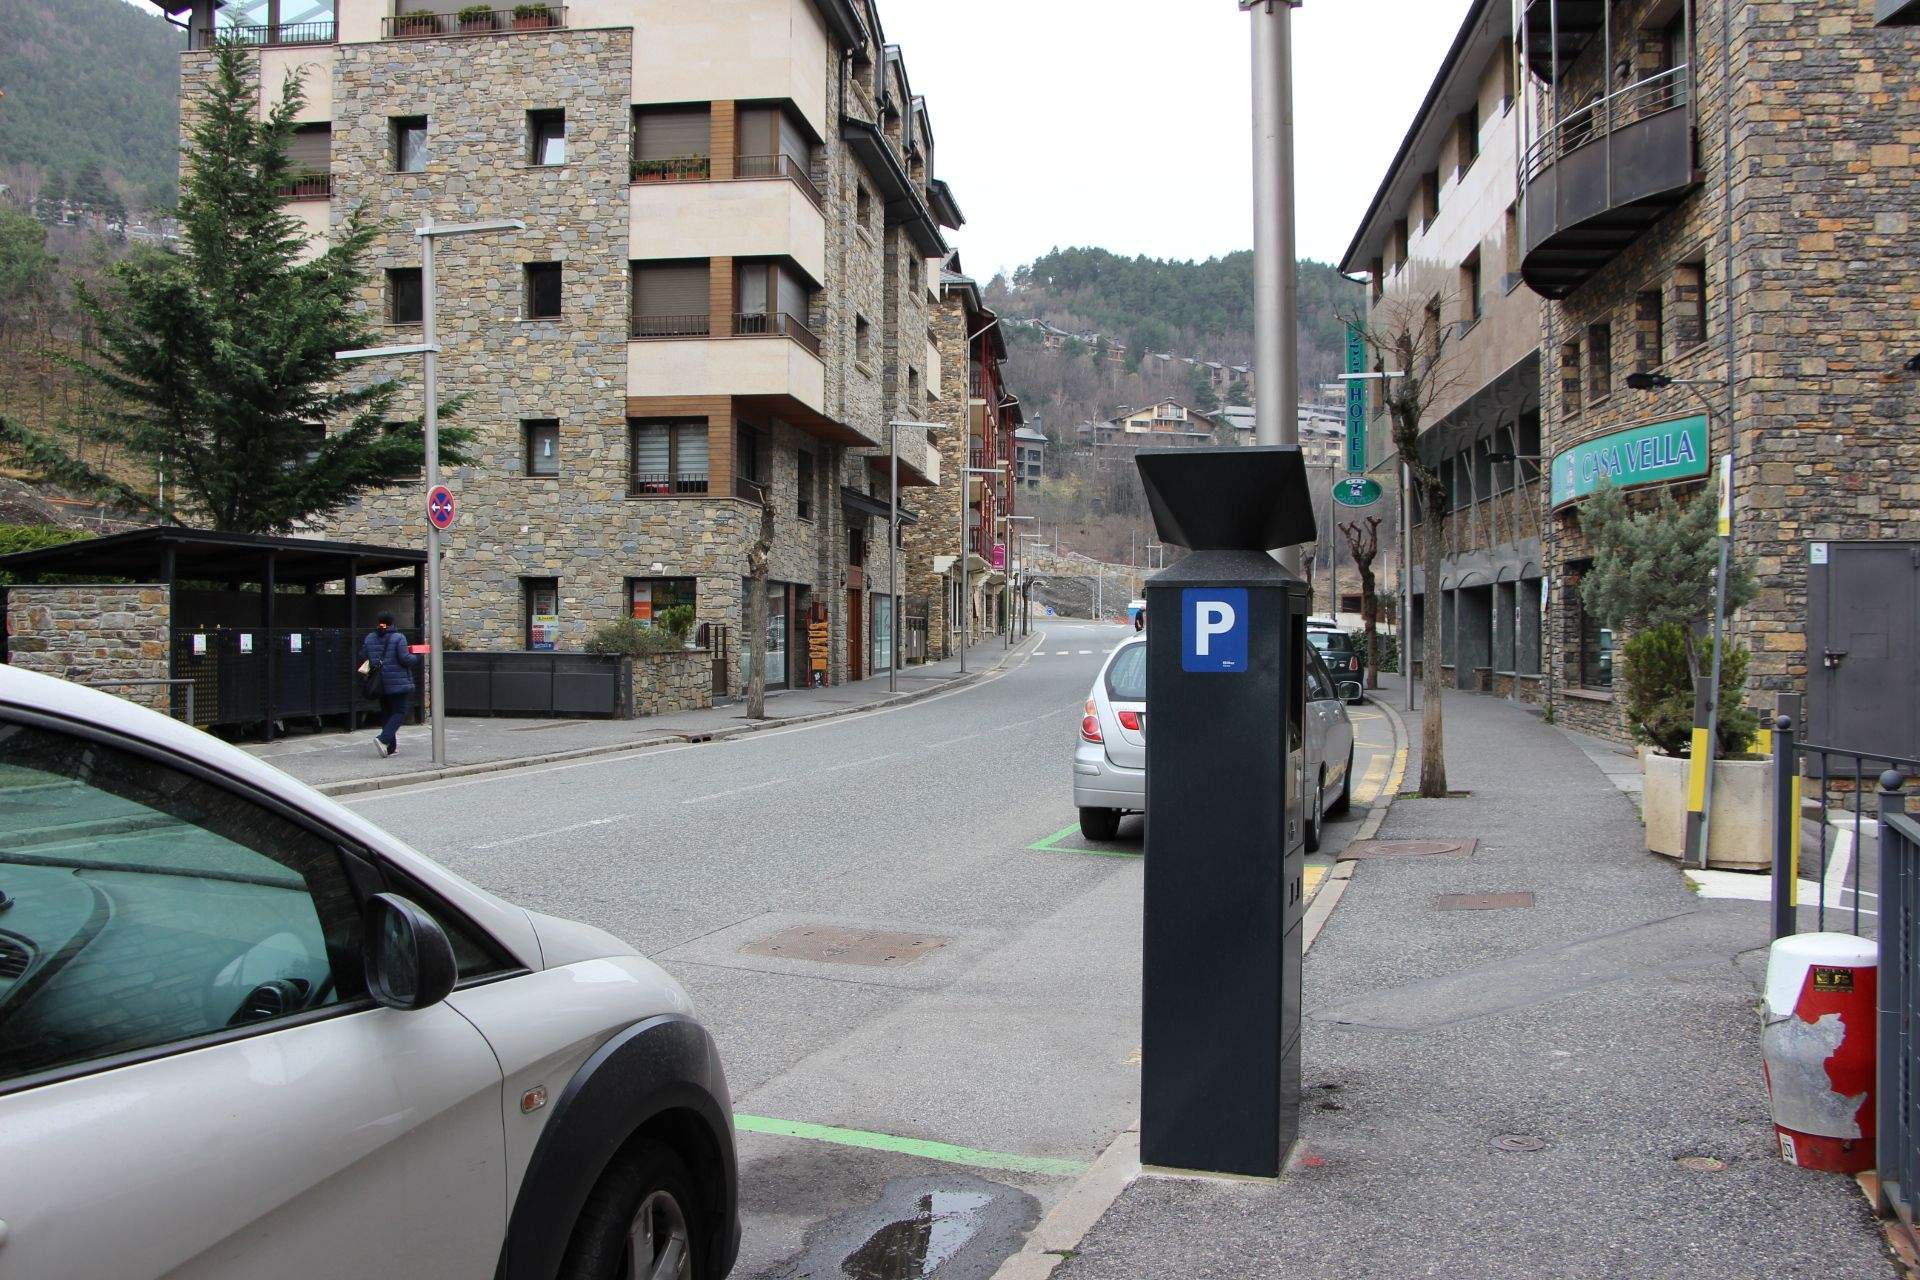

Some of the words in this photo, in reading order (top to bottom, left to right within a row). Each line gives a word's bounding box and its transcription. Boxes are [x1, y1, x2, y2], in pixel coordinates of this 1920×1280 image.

[1350, 388, 1363, 468] HOTEL
[1582, 446, 1622, 483] CASA
[1624, 430, 1697, 473] VELLA
[1196, 601, 1235, 655] P
